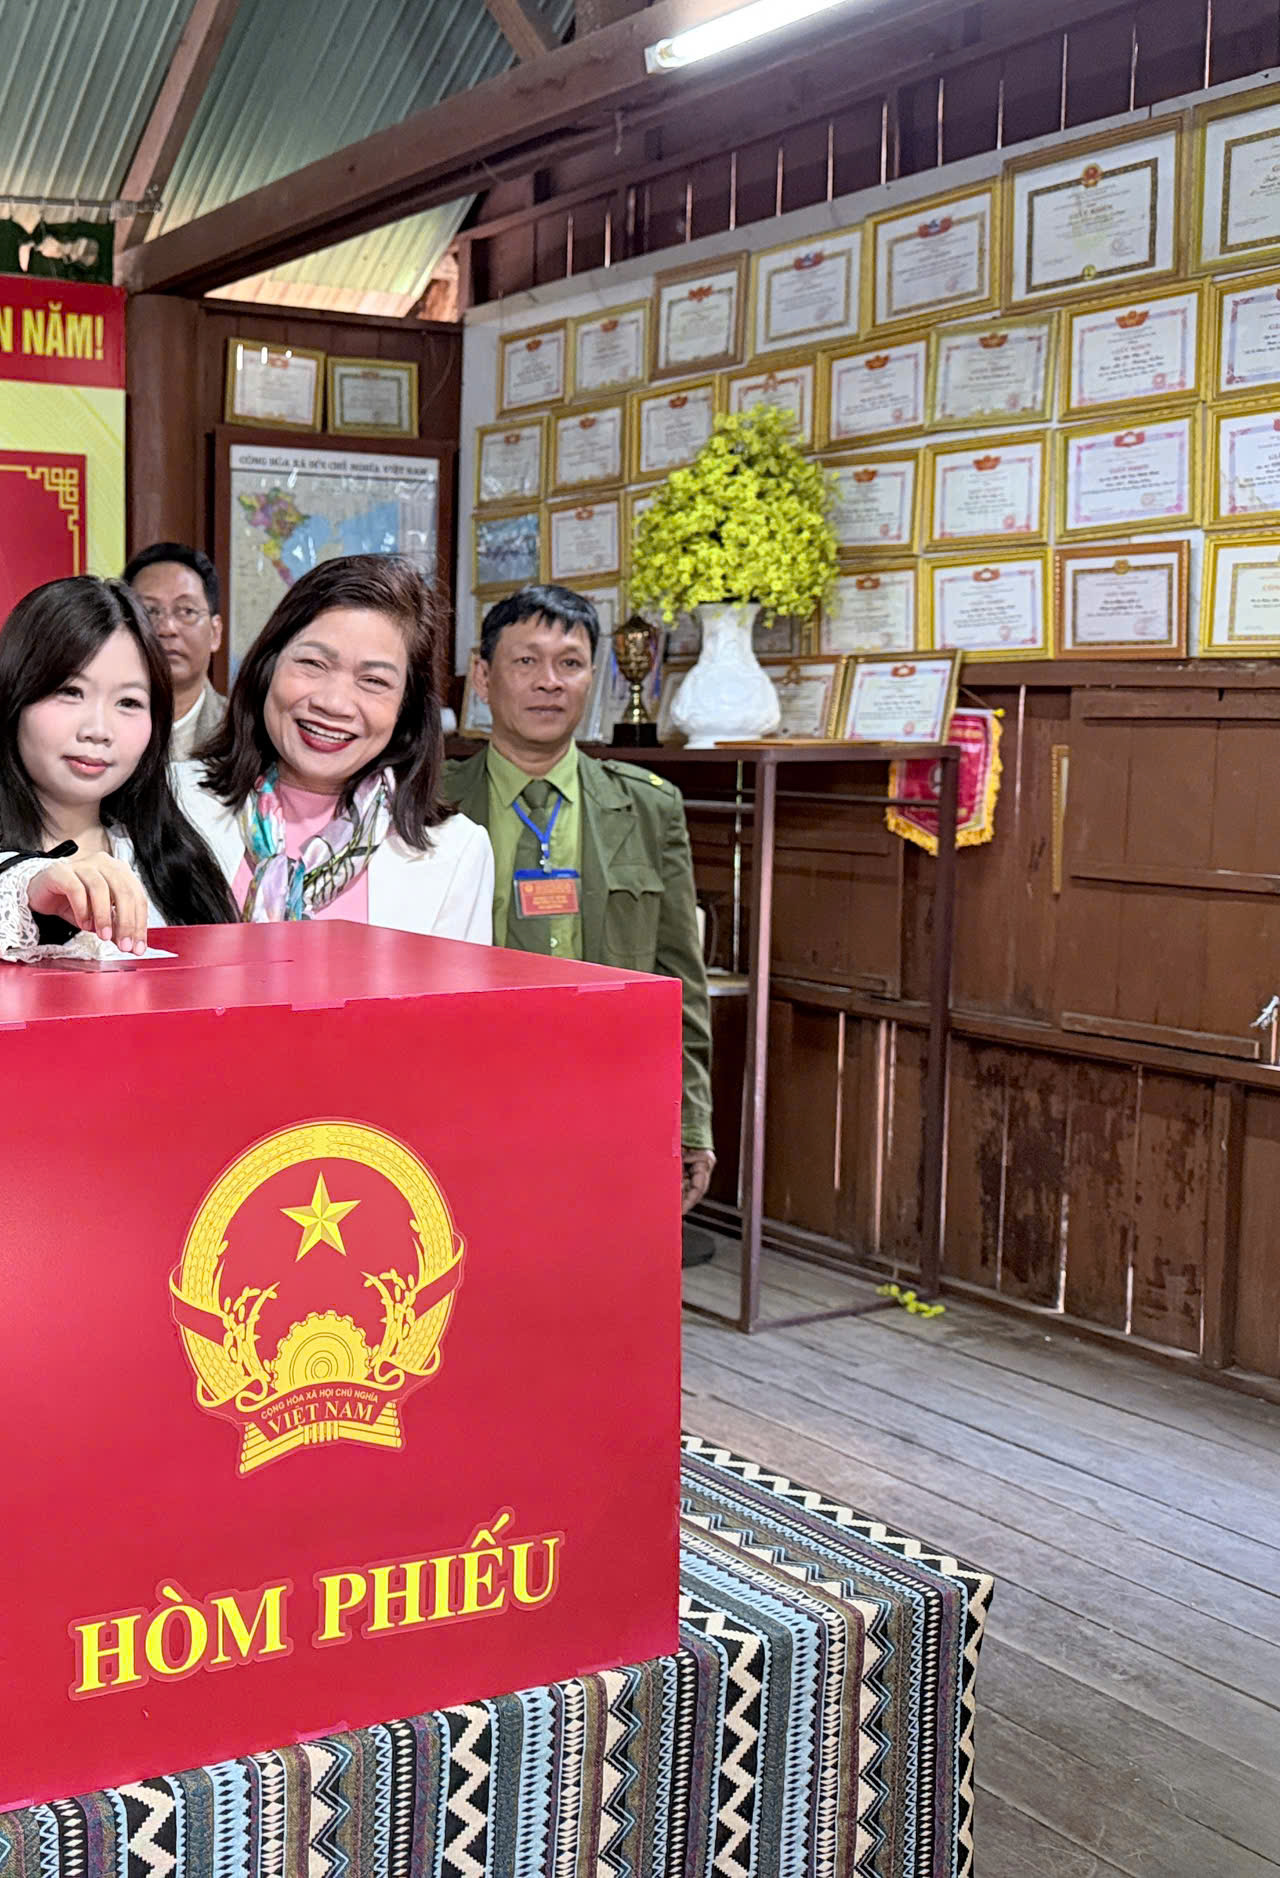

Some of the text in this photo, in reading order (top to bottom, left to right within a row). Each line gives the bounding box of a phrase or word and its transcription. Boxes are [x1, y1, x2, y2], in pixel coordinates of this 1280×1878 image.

[23, 304, 103, 360] NĂM!
[267, 1400, 374, 1435] VIỆT NAM
[76, 1514, 558, 1692] HÒM PHIẾU
